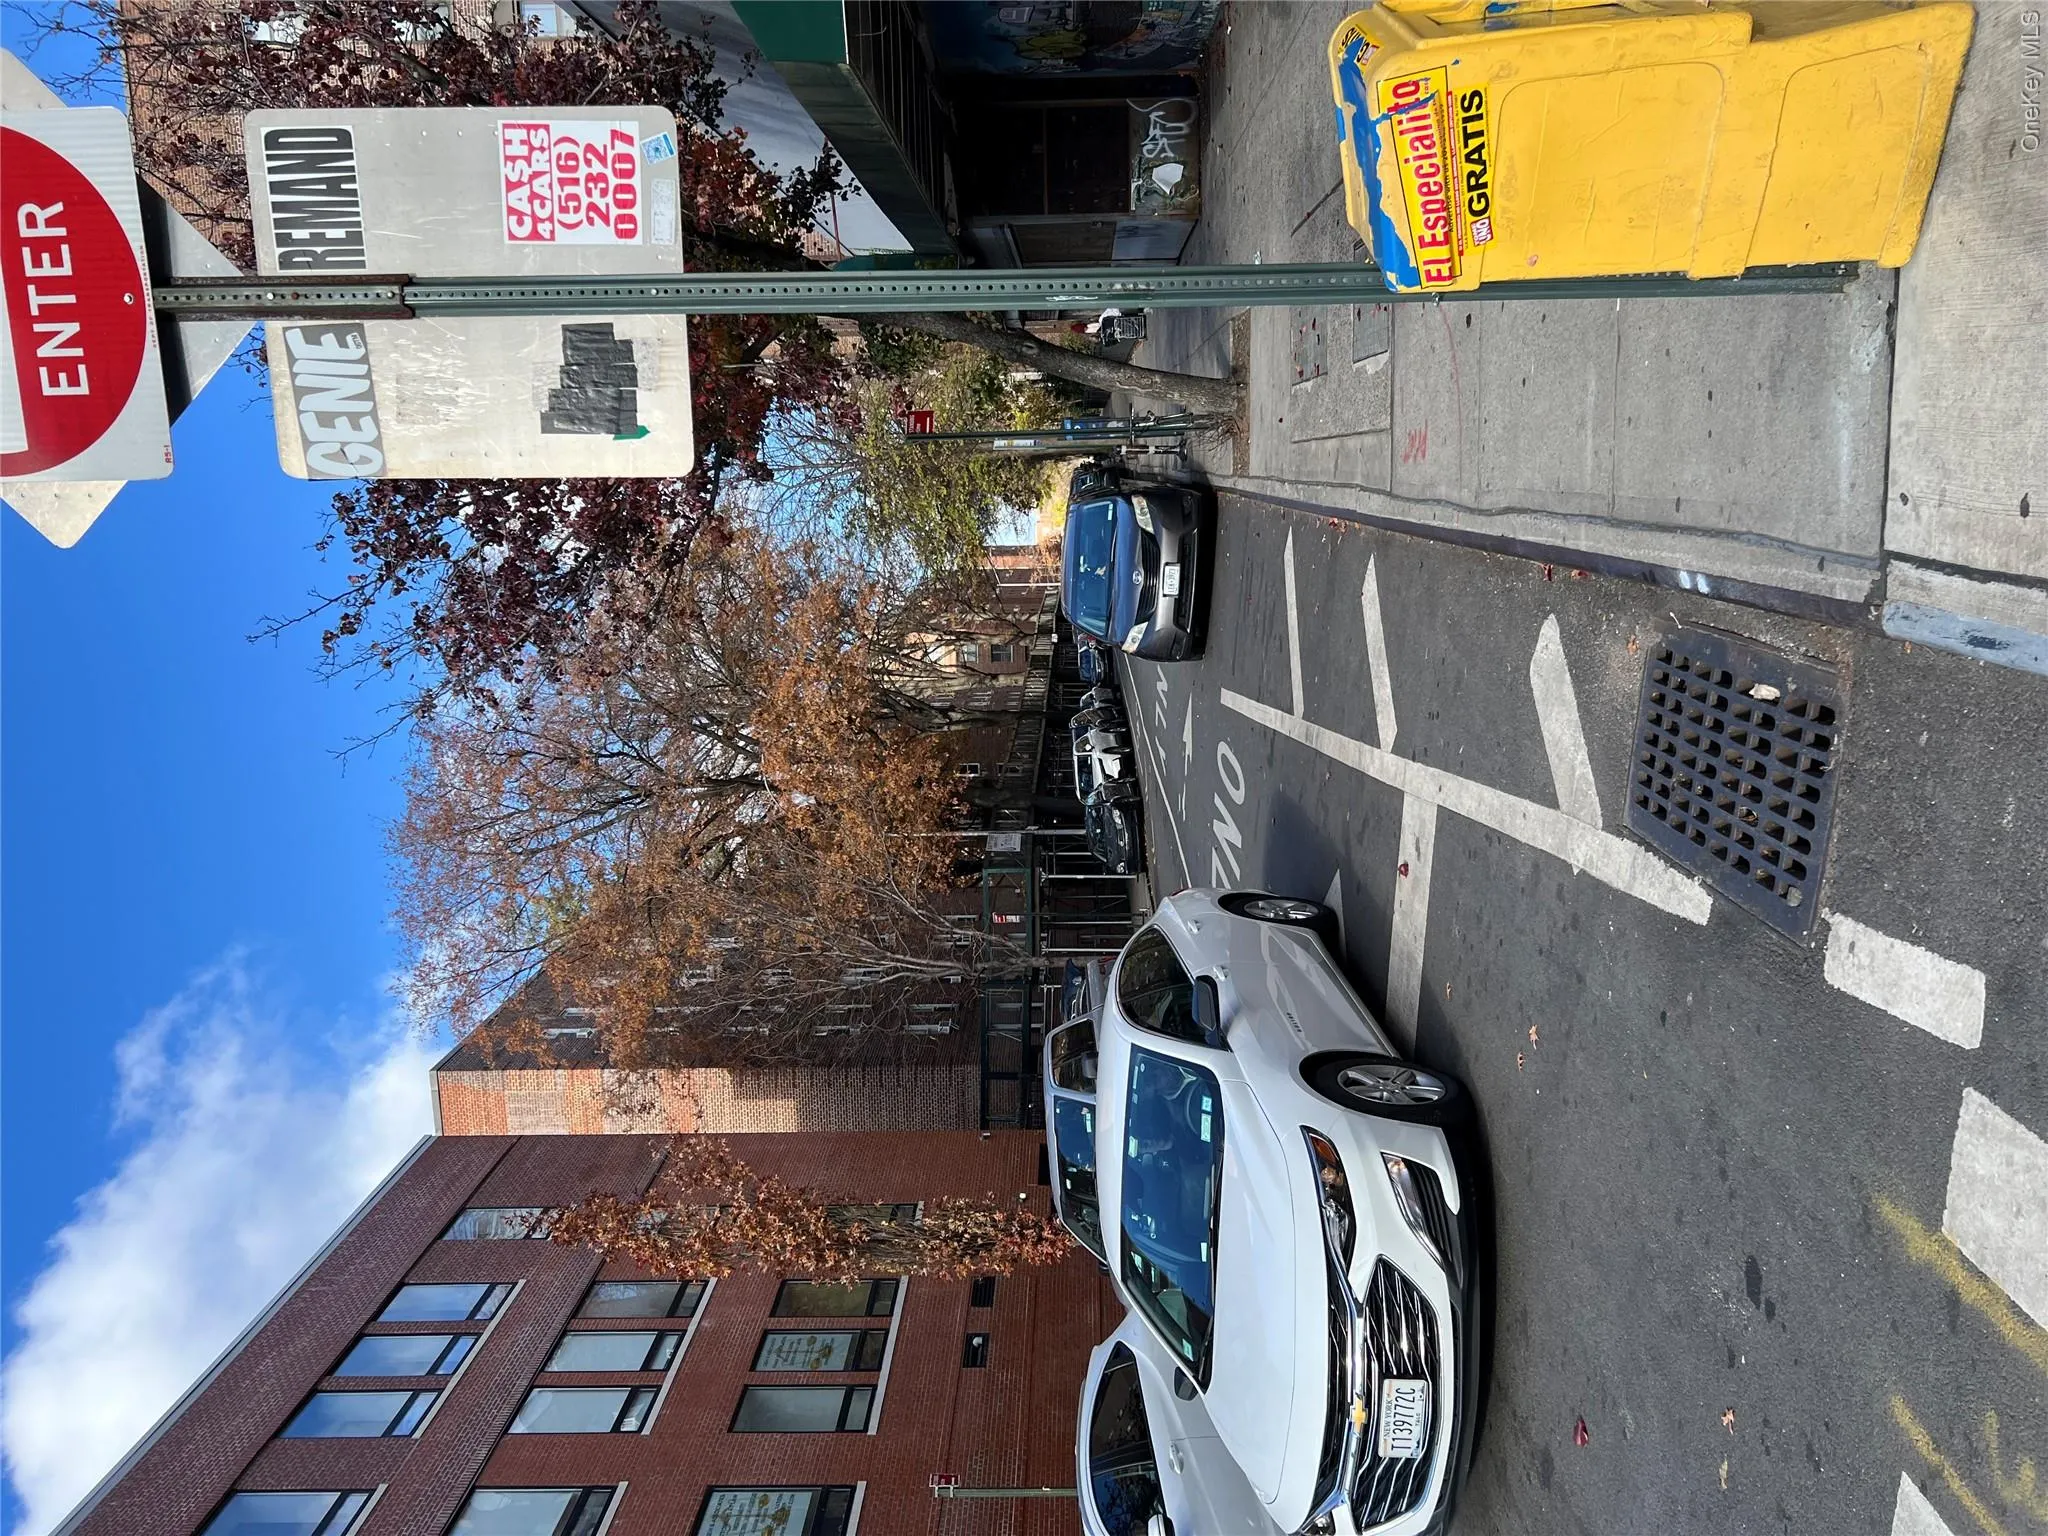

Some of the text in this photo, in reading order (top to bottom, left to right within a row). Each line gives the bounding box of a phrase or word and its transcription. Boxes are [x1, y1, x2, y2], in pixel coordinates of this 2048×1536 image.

[263, 127, 367, 271] REMAND
[529, 126, 554, 240] 4CARS
[553, 136, 583, 231] (516)
[583, 143, 611, 228] 232
[610, 128, 638, 240] 0007
[1388, 80, 1453, 283] El Especialito
[1442, 174, 1451, 187] with
[1460, 89, 1490, 217] GRATIS
[1443, 189, 1454, 233] Advertise
[1476, 219, 1491, 244] UNO
[16, 199, 90, 397] ENTER
[285, 327, 384, 476] GENIE
[1154, 664, 1168, 776] NLY
[1211, 741, 1246, 889] ONL
[1384, 1399, 1392, 1418] YORK
[1391, 1388, 1416, 1450] T139772C
